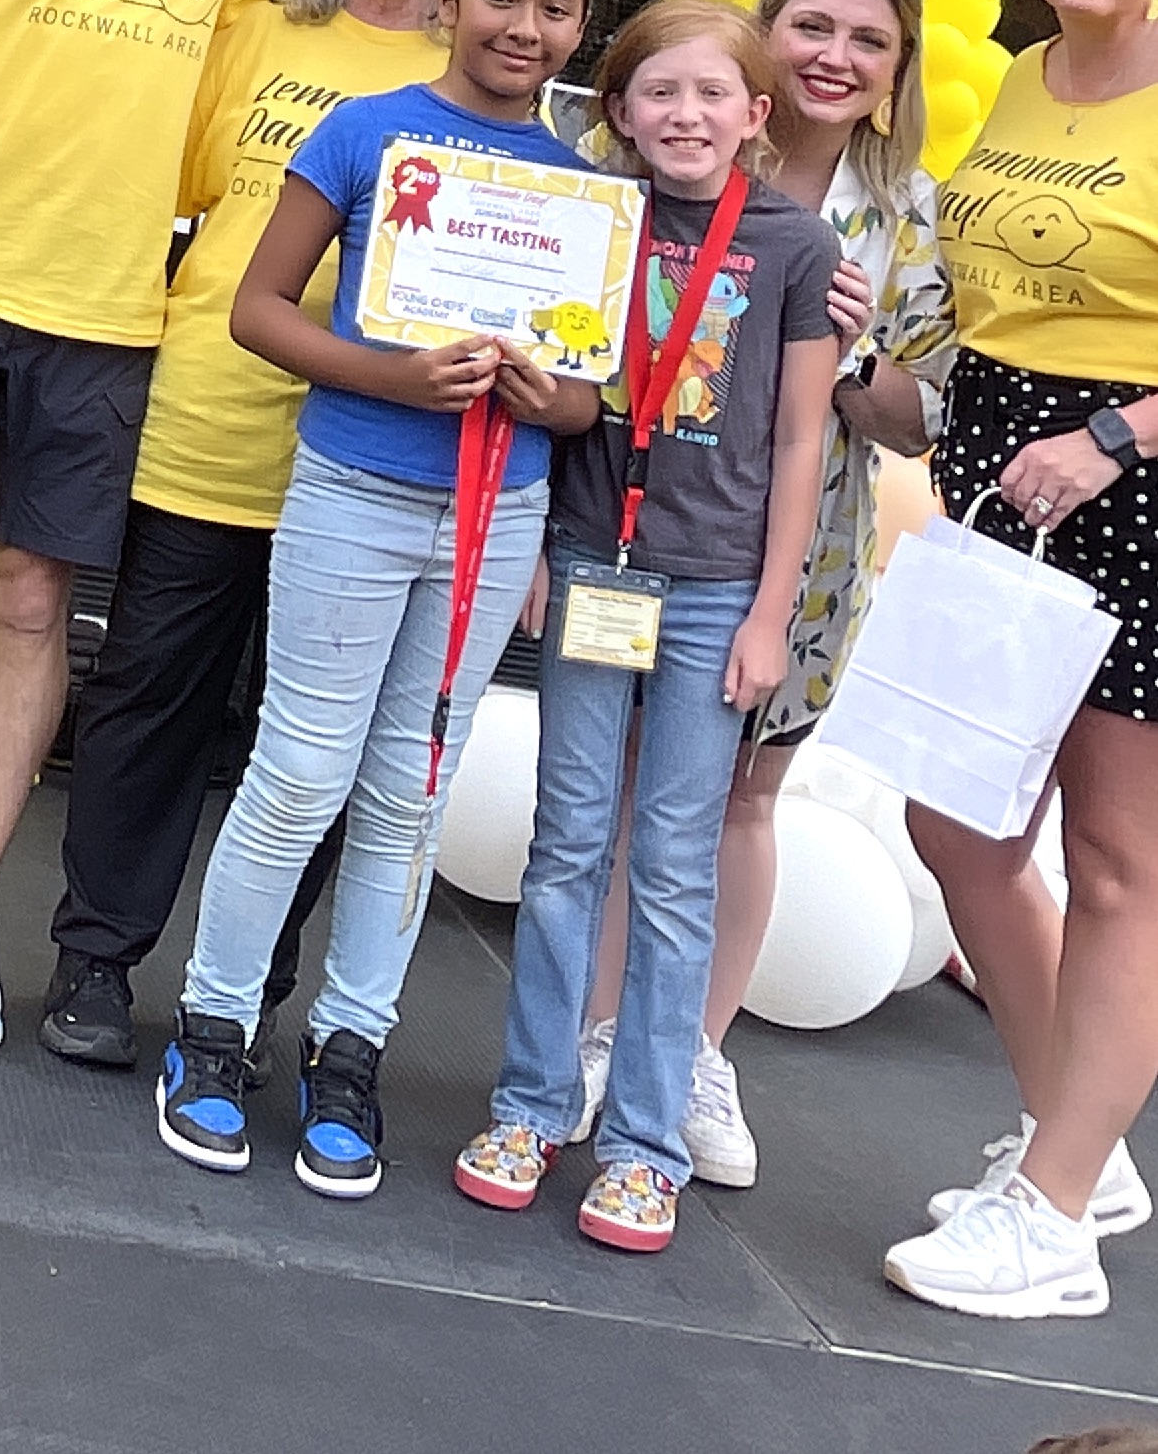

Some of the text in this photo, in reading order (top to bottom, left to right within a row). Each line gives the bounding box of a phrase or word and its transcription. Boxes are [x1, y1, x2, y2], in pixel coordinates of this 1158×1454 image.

[27, 6, 203, 62] ROCKWALL AREA
[398, 164, 437, 195] 2ND
[446, 218, 488, 241] BEST
[491, 226, 563, 256] TASTING
[1012, 276, 1086, 306] AREA
[675, 427, 720, 447] KANTO
